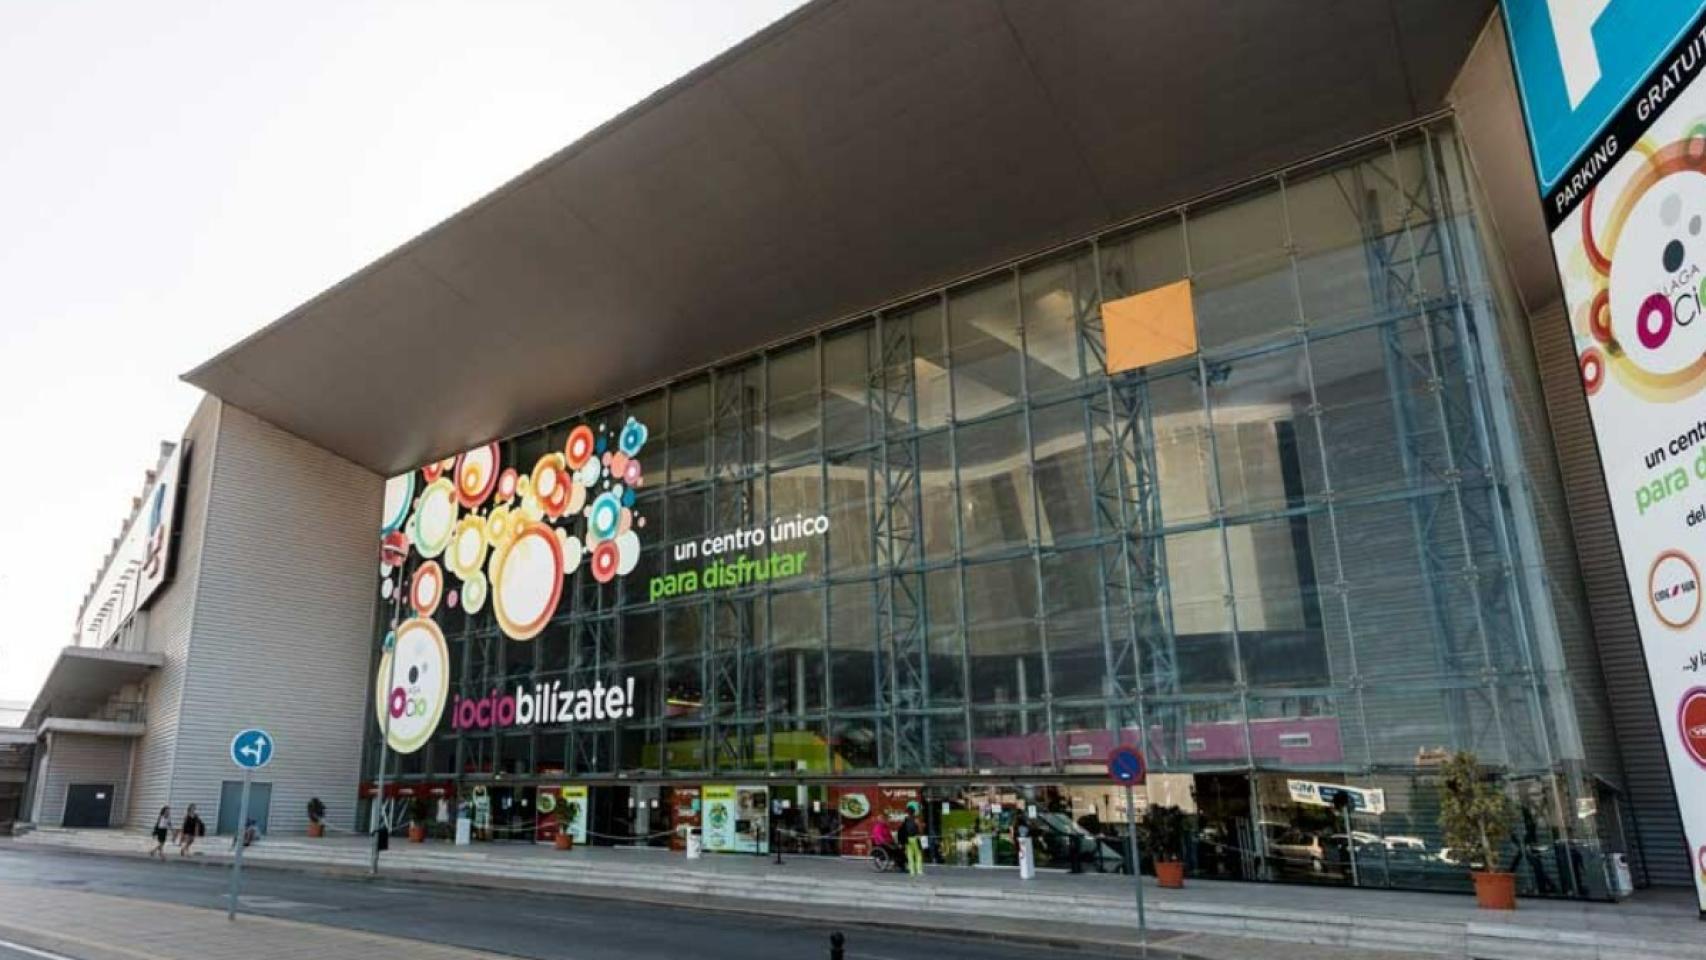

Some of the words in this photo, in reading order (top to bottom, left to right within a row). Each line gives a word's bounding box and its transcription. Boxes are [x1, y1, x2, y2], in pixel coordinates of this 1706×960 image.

[1555, 135, 1619, 213] PARKING
[1645, 447, 1666, 469] un
[1669, 421, 1706, 455] cent
[1635, 466, 1689, 515] para
[674, 540, 697, 561] un
[701, 526, 765, 556] centro
[770, 513, 829, 543] único
[1686, 504, 1706, 527] del
[650, 570, 698, 603] para
[703, 551, 807, 589] disfrutar
